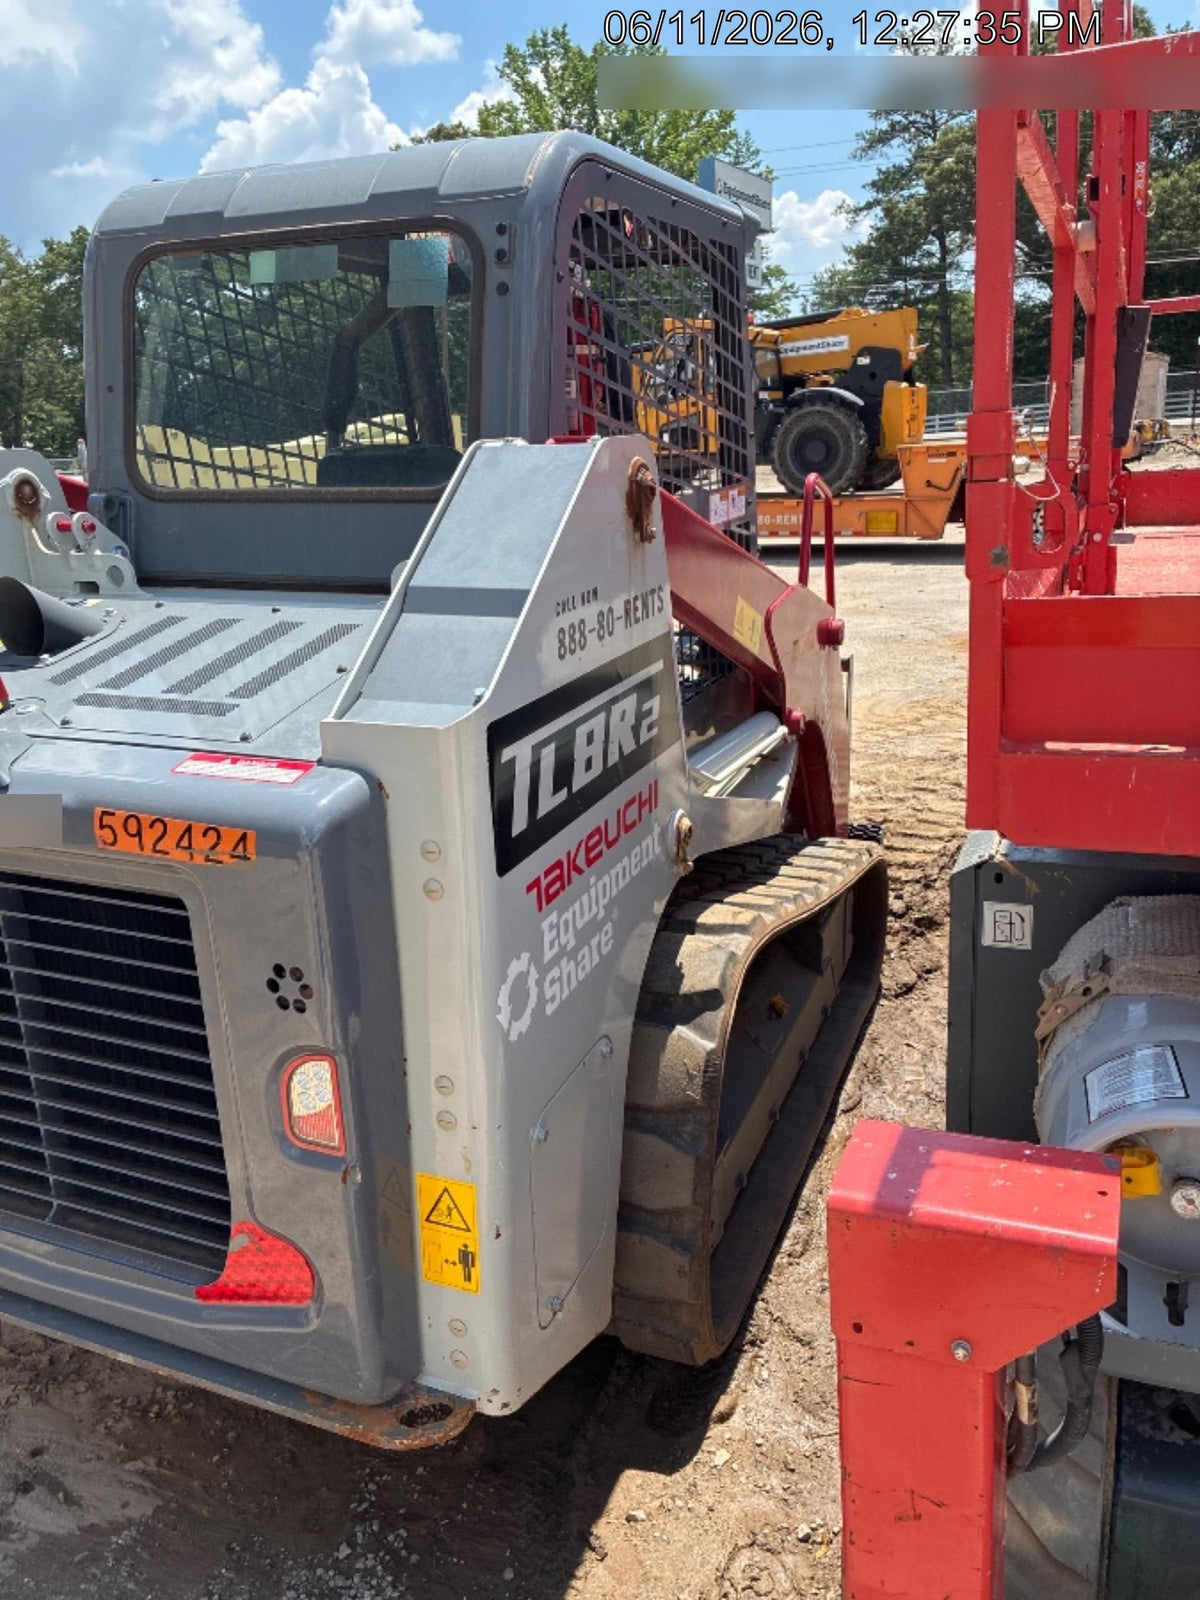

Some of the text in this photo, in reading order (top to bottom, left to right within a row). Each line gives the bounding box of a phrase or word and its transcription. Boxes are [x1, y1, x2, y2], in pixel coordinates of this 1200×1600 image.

[557, 584, 664, 660] 888-80-RENTS
[99, 810, 252, 865] 592424
[525, 779, 658, 914] TAKEUCHI
[541, 822, 662, 965] Equipment
[543, 921, 614, 1016] Share
